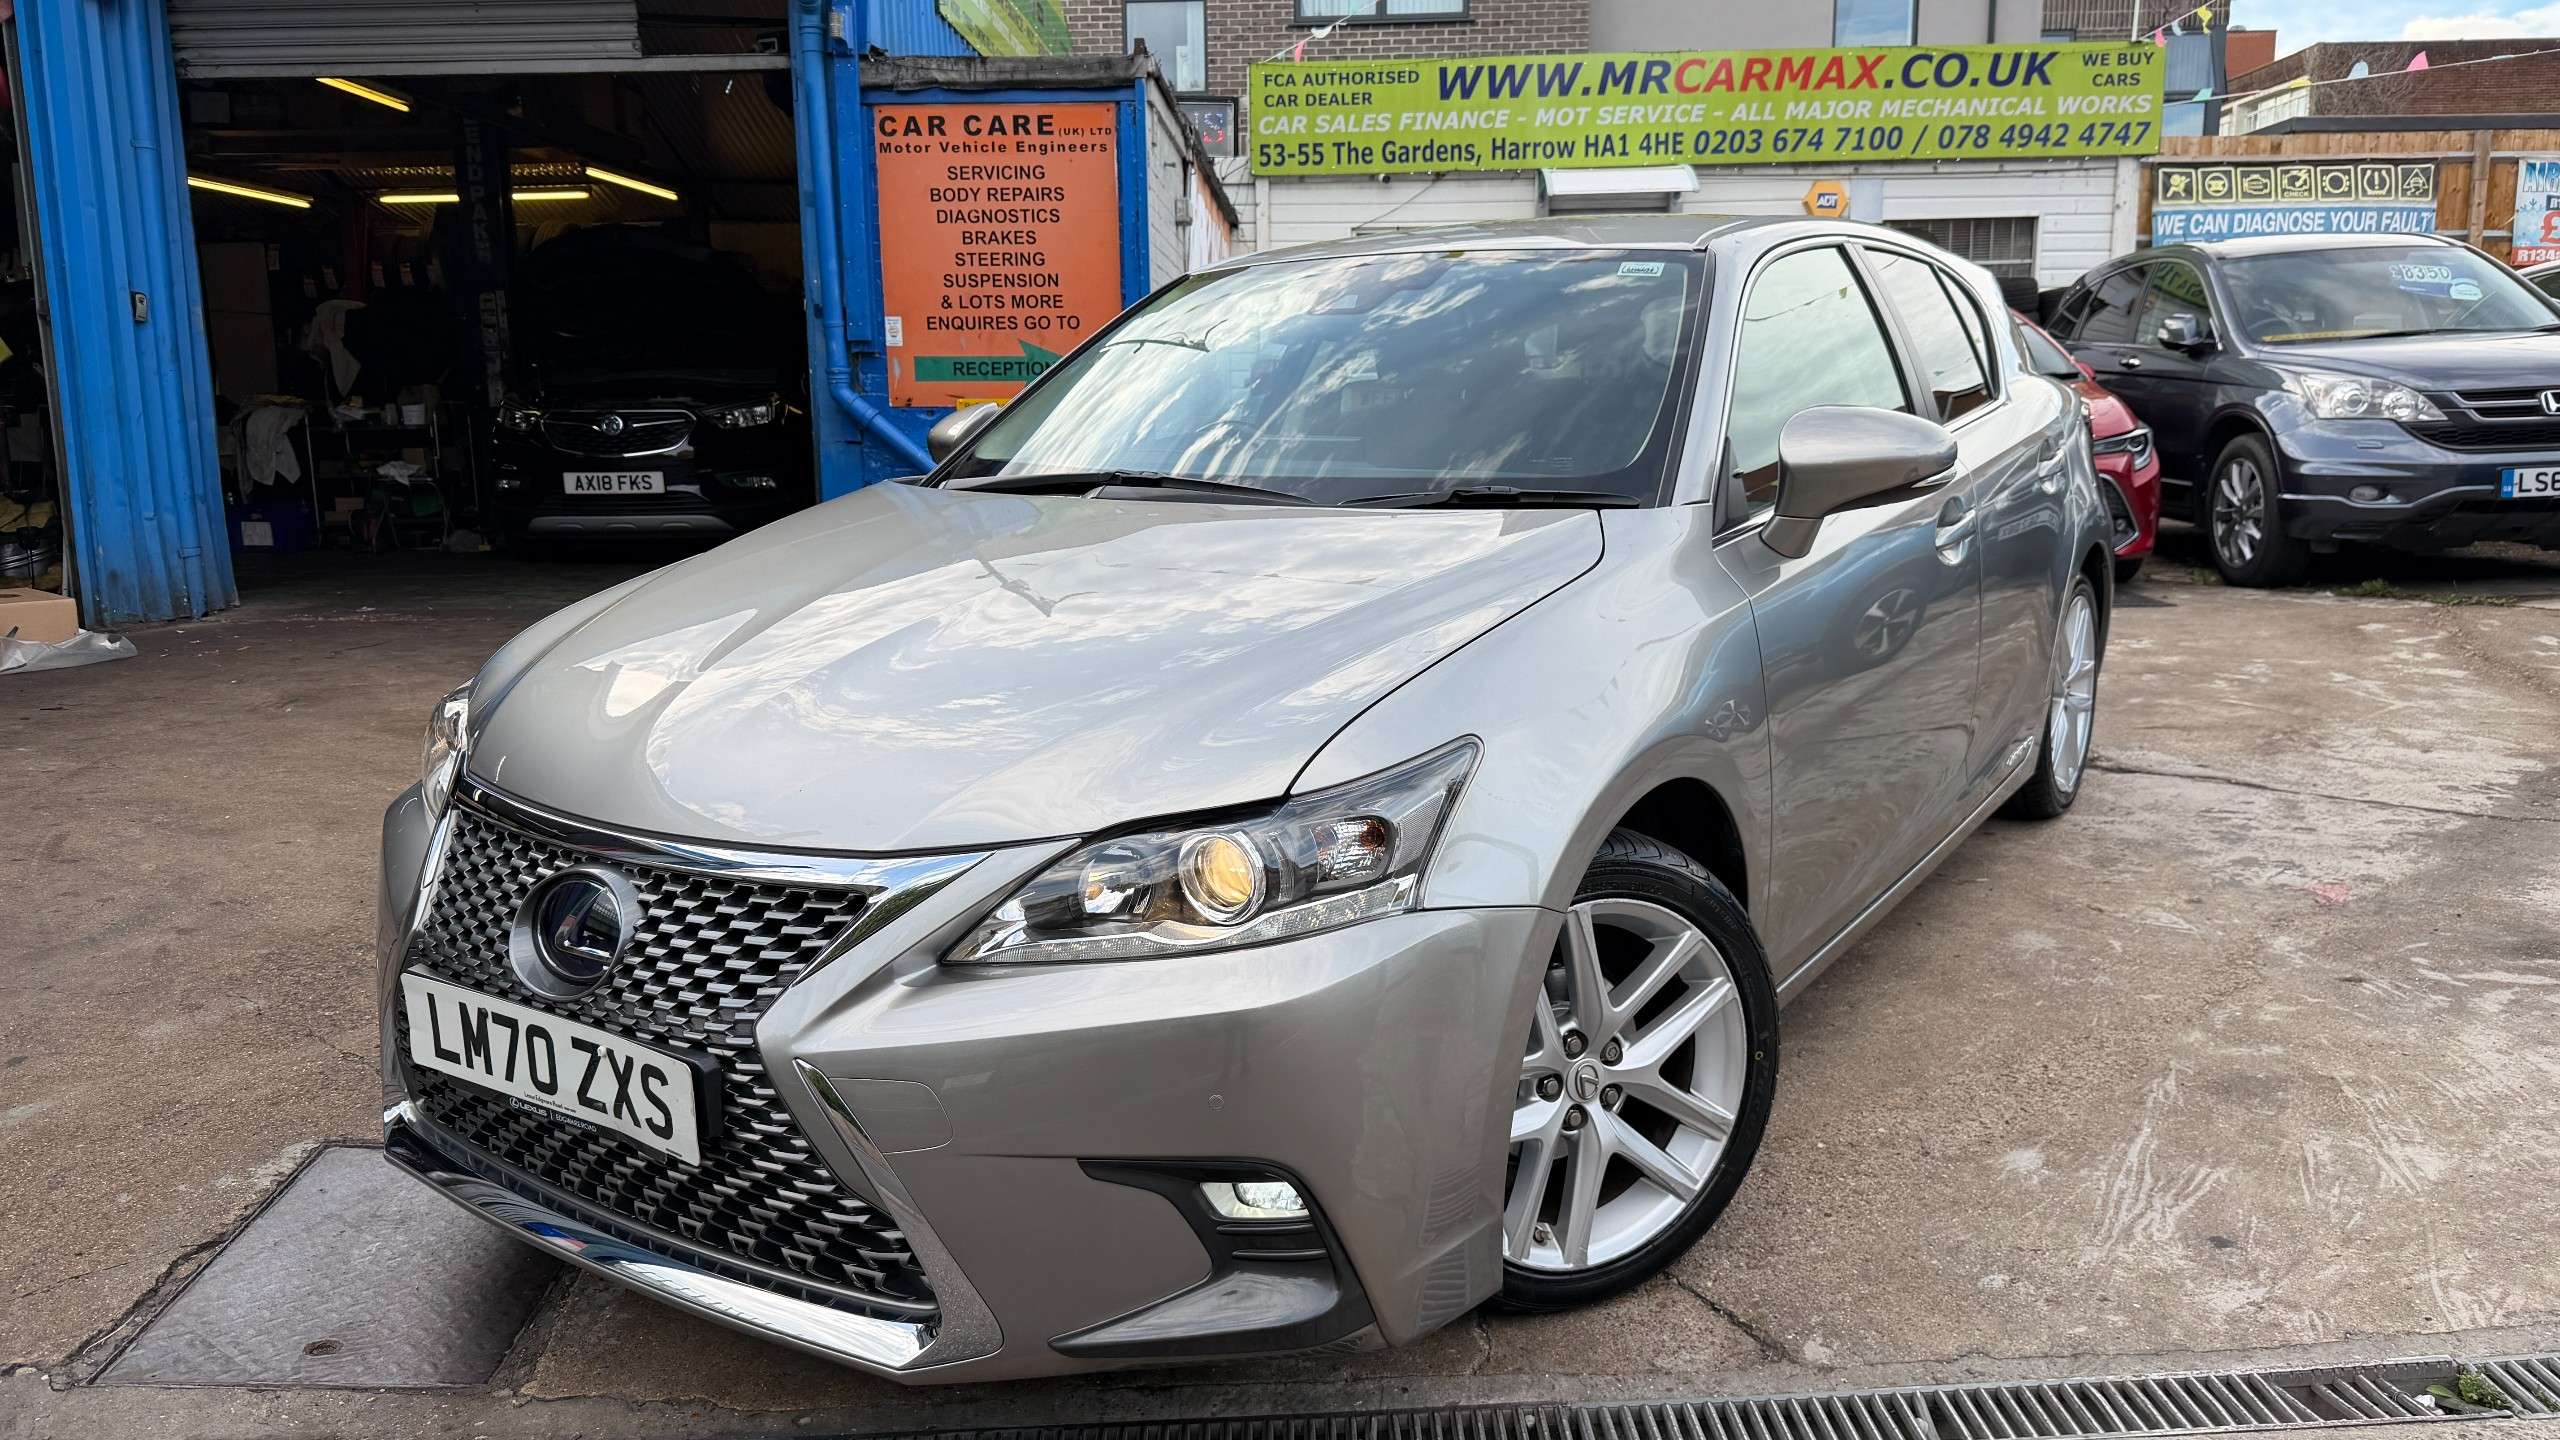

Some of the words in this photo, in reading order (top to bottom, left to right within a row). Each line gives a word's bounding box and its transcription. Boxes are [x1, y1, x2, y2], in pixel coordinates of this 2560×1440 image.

[2082, 53, 2110, 67] WE
[2117, 52, 2154, 66] BUY
[1263, 74, 1296, 87] FCA
[1302, 71, 1420, 87] AUTHORISED
[1439, 51, 2059, 101] WWW.MRCARMAX.CO.UK
[2092, 73, 2141, 87] CARS
[1263, 94, 1299, 108] CAR
[1305, 92, 1373, 107] DEALER
[1258, 115, 1307, 135] CAR
[1314, 112, 1392, 133] SALES
[1398, 109, 1510, 132] FINANCE
[1534, 107, 1591, 127] MOT
[1596, 103, 1707, 126] SERVICE
[1730, 101, 1776, 122] ALL
[1784, 100, 1873, 121] MAJOR
[1879, 96, 2047, 118] MECHANICAL
[2057, 94, 2153, 115] WORKS
[878, 114, 947, 137] CAR
[963, 114, 1055, 137] CARE
[1058, 128, 1085, 138] (UK)
[1089, 127, 1112, 136] LTD
[878, 141, 931, 154] Motor
[939, 141, 1008, 154] Vehicle
[1015, 140, 1109, 156] Engineers
[1258, 142, 1324, 168] 53-55
[1332, 140, 1374, 165] The
[1381, 138, 1482, 167] Gardens,
[1491, 136, 1576, 161] Harrow
[1584, 133, 1630, 158] HA1
[1638, 132, 1684, 156] 4HE
[1693, 128, 1763, 155] 0203
[1772, 127, 1824, 153] 674
[1832, 126, 1903, 152] 7100
[1938, 123, 1991, 149] 078
[1999, 122, 2070, 149] 4942
[2078, 121, 2152, 147] 4747
[947, 164, 1046, 181] SERVICING
[929, 187, 981, 203] BODY
[986, 186, 1065, 202] REPAIRS
[1816, 195, 1838, 207] ADT
[936, 208, 1061, 224] DIAGNOSTICS
[2156, 213, 2186, 235] WE
[2189, 213, 2230, 234] CAN
[2232, 211, 2326, 233] DIAGNOSE
[2329, 210, 2378, 232] YOUR
[2380, 210, 2434, 233] FAULT
[961, 230, 1037, 245] BRAKES
[954, 252, 1046, 267] STEERING
[942, 273, 1059, 289] SUSPENSION
[940, 295, 952, 309] &
[958, 295, 1006, 309] LOTS
[1010, 294, 1064, 309] MORE
[926, 315, 1018, 331] ENQUIRES
[1023, 315, 1051, 330] GO
[1056, 315, 1081, 330] TO
[575, 474, 613, 491] AX18
[617, 474, 653, 491] FKS
[426, 992, 560, 1097] LM70
[570, 1035, 675, 1141] ZXS
